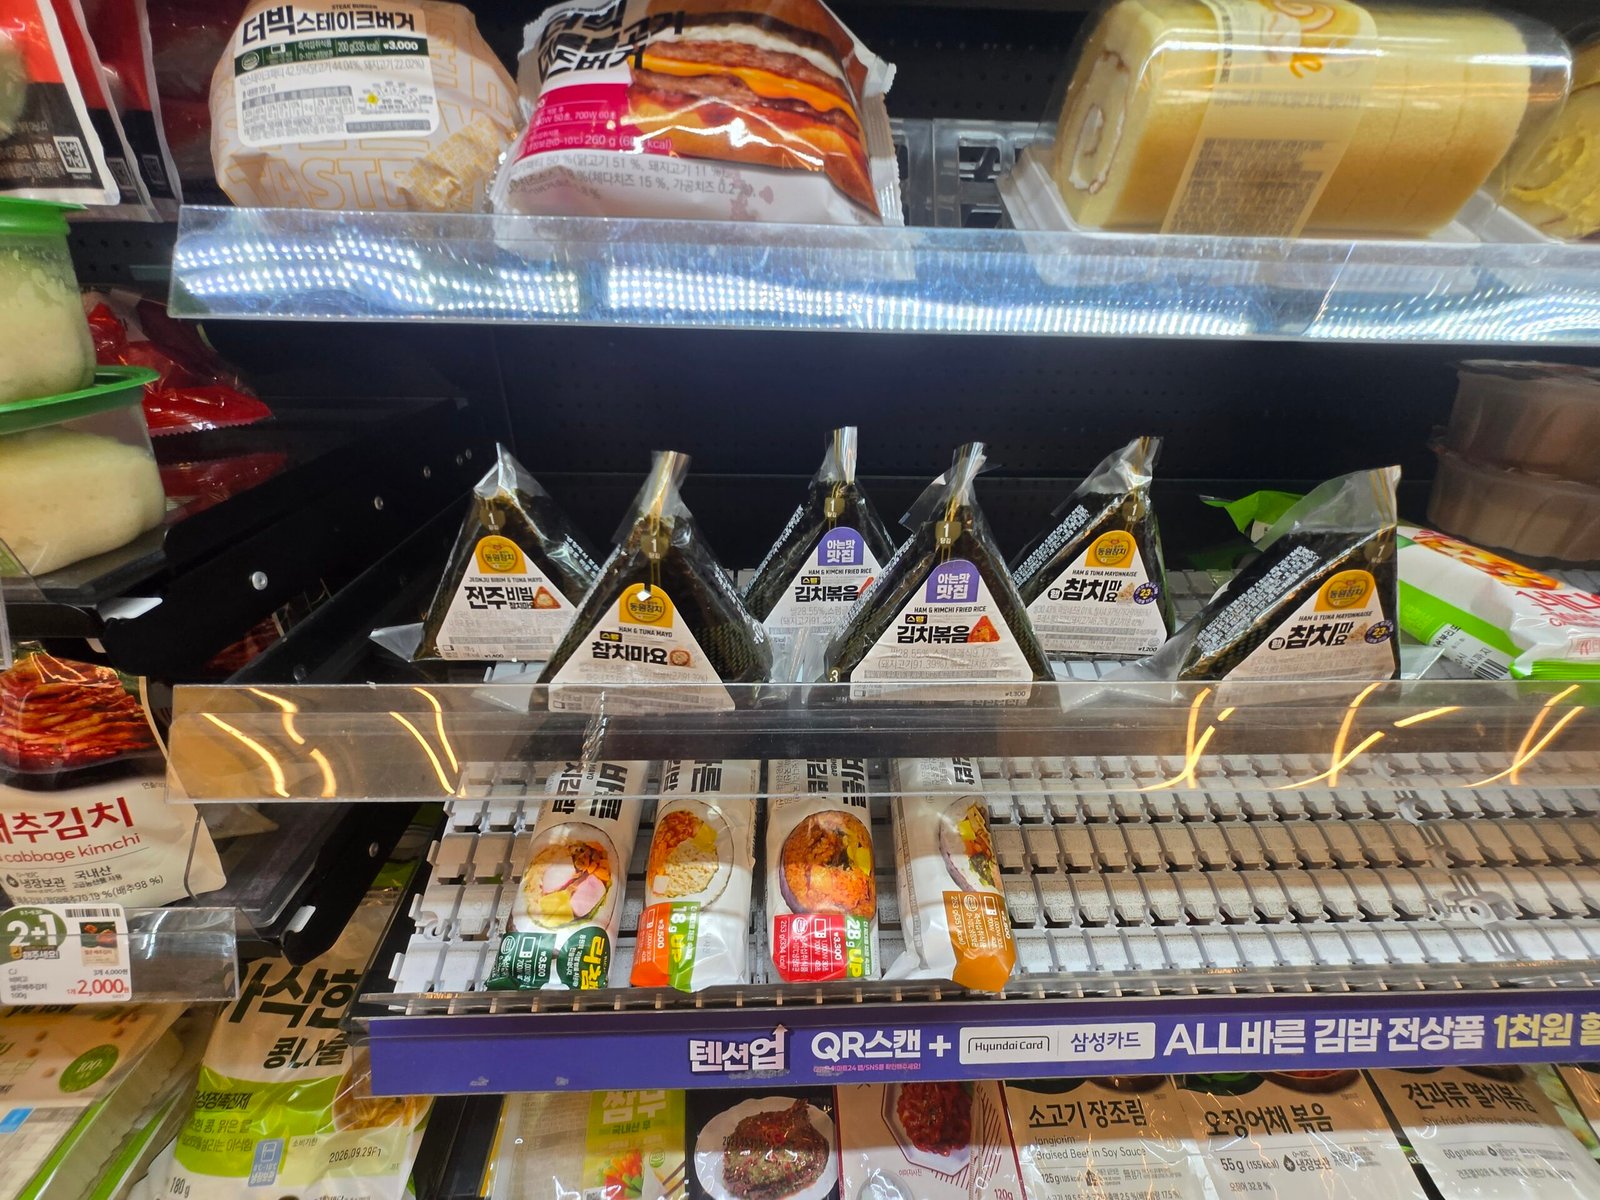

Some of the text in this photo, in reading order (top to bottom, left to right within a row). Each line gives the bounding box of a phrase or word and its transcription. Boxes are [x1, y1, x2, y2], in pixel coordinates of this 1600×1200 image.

[585, 135, 672, 150] 260 g kcal)
[613, 156, 625, 168] 51
[648, 160, 691, 177] 돼지고기
[639, 176, 652, 188] 15
[673, 179, 715, 194] 가공치즈
[827, 539, 856, 550] 아는맛
[826, 549, 855, 564] 맛집
[937, 573, 970, 585] 아는맛
[795, 586, 859, 603] 김치볶음
[936, 585, 968, 600] 맛집
[1319, 613, 1335, 621] TUNA
[639, 628, 655, 636] TUNA
[656, 630, 673, 638] MAYO
[897, 625, 970, 644] 김치볶음
[592, 641, 668, 665] 참치마요
[5, 833, 141, 863] cabbage kimchi
[74, 865, 113, 880] 국내산
[19, 876, 66, 889] 냉장보관
[7, 914, 58, 947] 2+1
[848, 948, 864, 978] UP
[1070, 1031, 1142, 1054] 삼성카드
[1163, 1019, 1306, 1056] ALL바른
[1314, 1018, 1381, 1053] 김밥
[1388, 1015, 1485, 1050] 전상품
[1494, 1013, 1572, 1048] 1천원
[263, 1033, 349, 1069] 콩나물
[689, 1025, 787, 1072] 텐션업
[811, 1029, 921, 1062] QR스캔
[1401, 1081, 1539, 1114] 견과류 멸치볶음
[1028, 1098, 1148, 1130] 소고기 장조림
[1204, 1102, 1334, 1139] 오징어채 볶음
[220, 1119, 239, 1133] 맑은
[1071, 1149, 1089, 1159] Beef
[1091, 1149, 1101, 1158] in
[1102, 1147, 1119, 1159] Soy
[1121, 1146, 1147, 1157] Sauce
